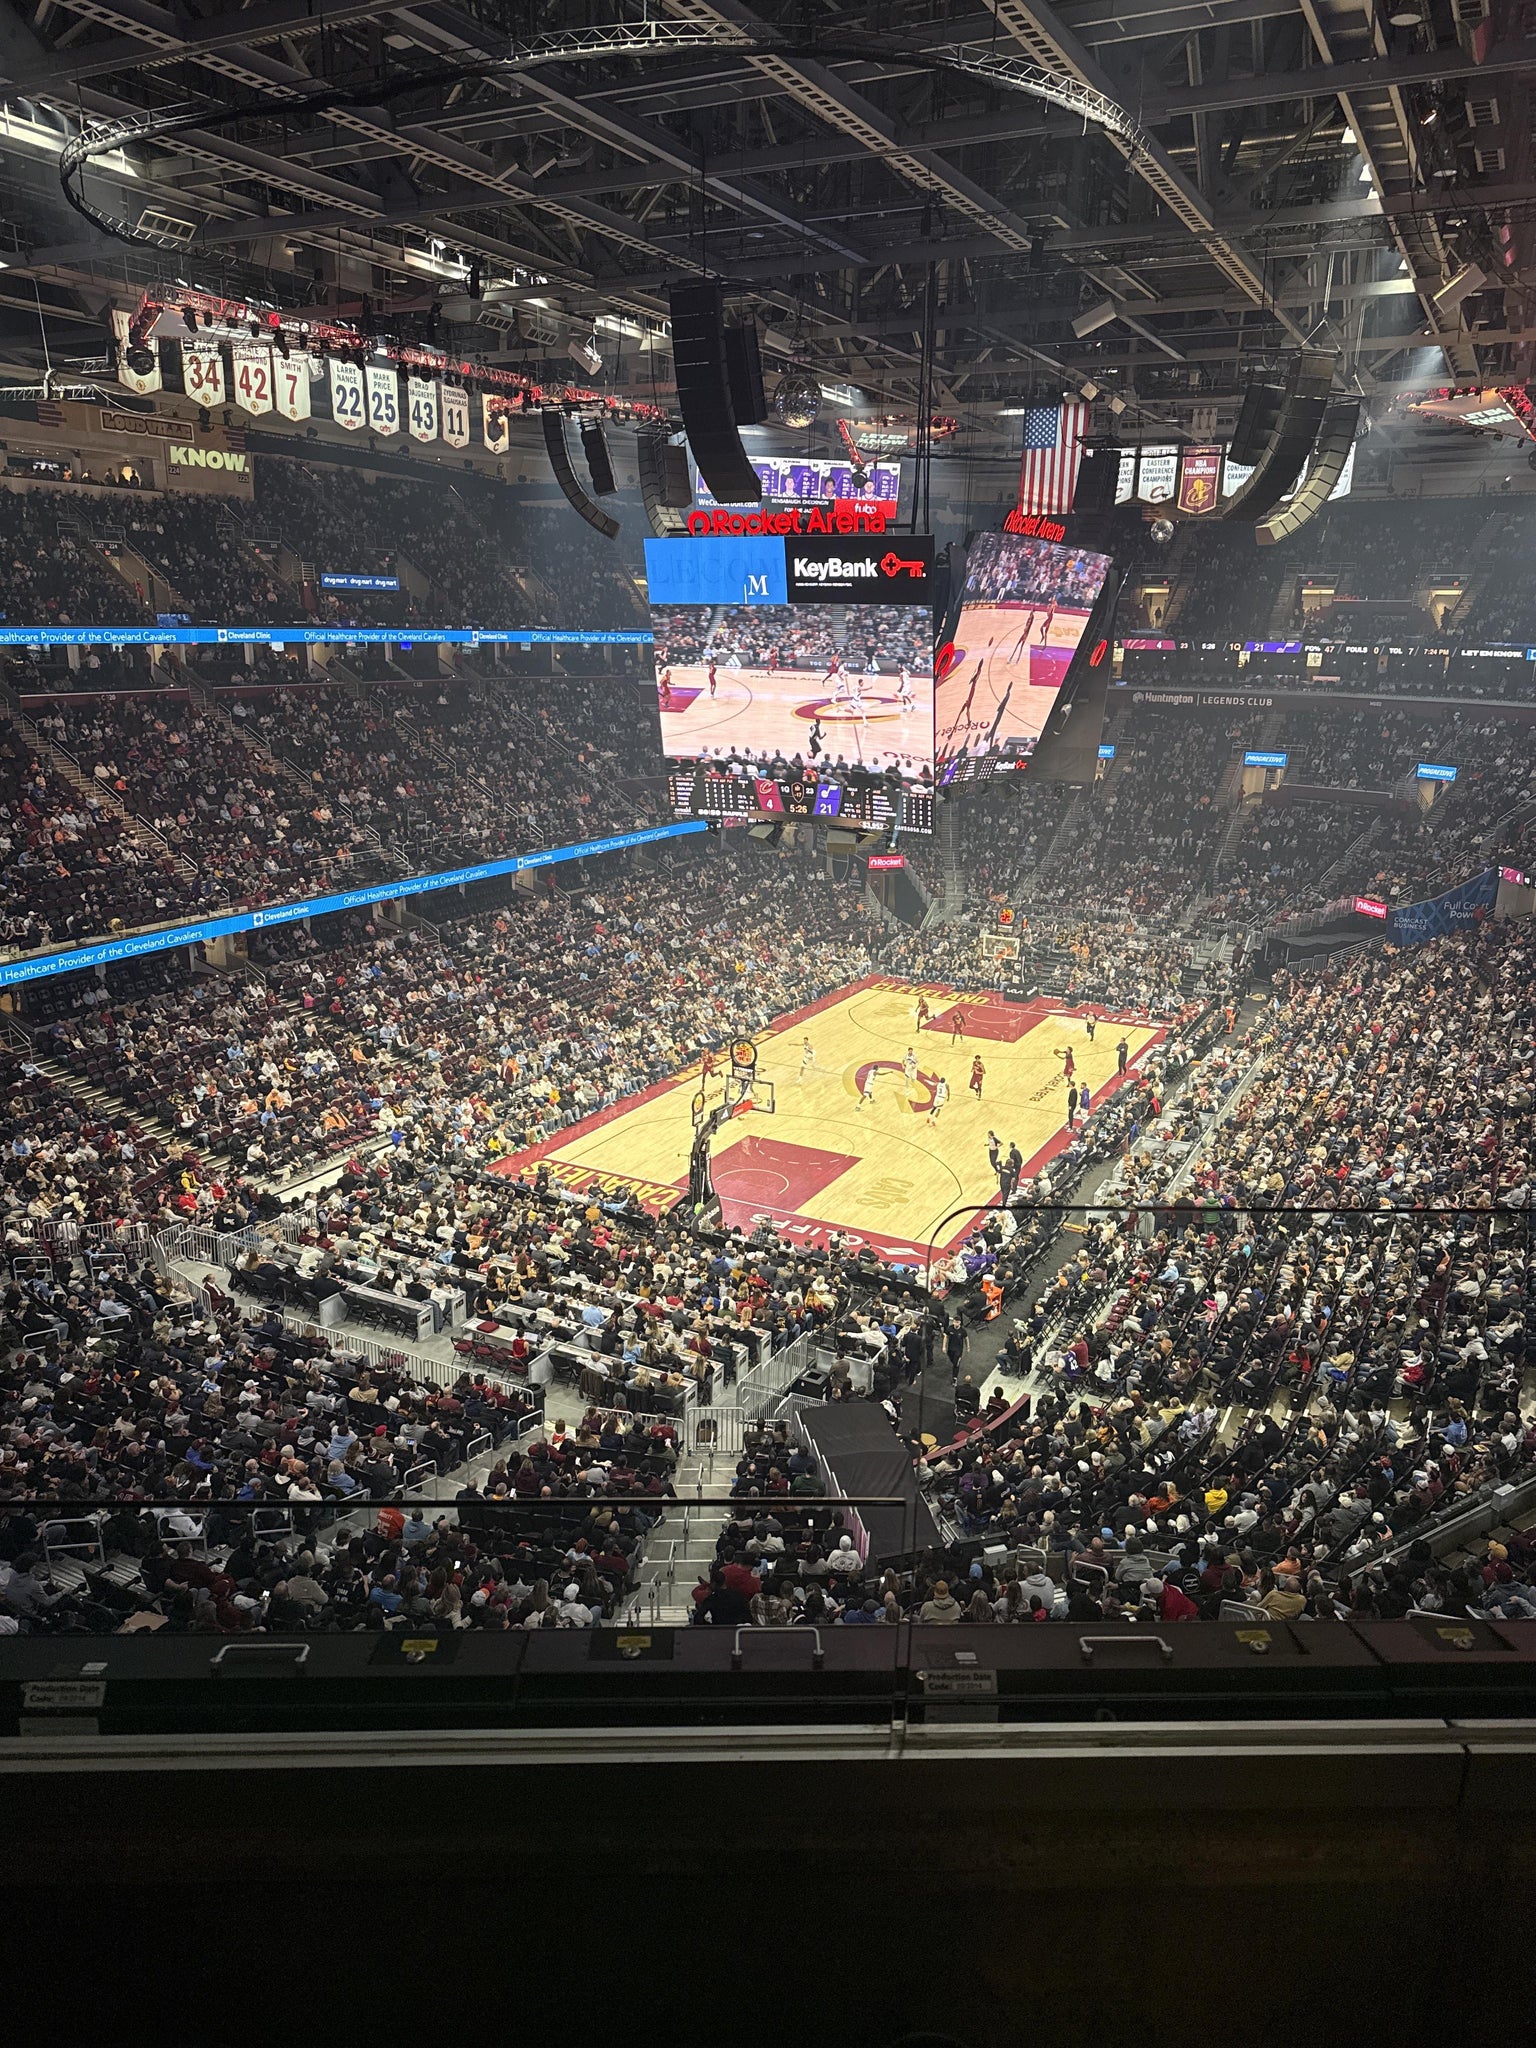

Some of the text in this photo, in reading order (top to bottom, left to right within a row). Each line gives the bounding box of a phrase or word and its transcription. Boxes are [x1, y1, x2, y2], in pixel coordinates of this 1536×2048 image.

[280, 361, 302, 373] SMITH
[336, 365, 357, 376] LARRY
[189, 355, 221, 392] 34
[373, 372, 390, 382] MARK
[239, 365, 268, 400] 42
[336, 374, 358, 385] NANCE
[373, 380, 392, 390] PRICE
[285, 373, 298, 405] 7
[414, 381, 429, 390] BRAD
[335, 384, 362, 418] 22
[371, 390, 396, 423] 25
[411, 400, 434, 431] 43
[447, 407, 465, 437] 11
[170, 445, 250, 473] KNOW.
[1142, 467, 1174, 476] CONFERENCE
[1184, 466, 1216, 475] CHAMPIONS
[1142, 475, 1173, 483] CHAMPIONS
[713, 507, 886, 535] Rocket Arena
[1006, 510, 1066, 542] Rocket Arena
[794, 557, 878, 580] KeyBank
[0, 631, 177, 642] ealthcare Provider of the Cleveland Cavaliers
[228, 631, 271, 640] Cleveland Clinic
[304, 631, 446, 641] Official Healthcare Provider of the Cleveland Cavaliers
[532, 632, 551, 642] Official
[552, 633, 579, 642] Healthcare
[580, 633, 600, 643] Provider
[607, 634, 616, 642] the
[616, 634, 642, 643] Cleveland
[1156, 641, 1162, 649] 4
[1254, 643, 1265, 651] 21
[1324, 646, 1335, 654] 47
[1345, 646, 1380, 655] FOULS 0
[1389, 647, 1414, 656] TOL 7
[1145, 691, 1273, 707] Huntington LEGENDS CLUB
[1246, 755, 1284, 764] PROGRESSIVE
[766, 799, 774, 809] 4
[790, 804, 808, 814] 5:26
[820, 803, 832, 814] 21
[343, 869, 488, 906] Official Healthcare Provider of the Cleveland Cavaliers
[1362, 903, 1386, 915] Rocket
[1443, 901, 1490, 910] Full Cort
[264, 905, 310, 922] Cleveland Clinic
[1450, 910, 1475, 919] Pow
[1394, 916, 1428, 925] COMCAST
[1393, 923, 1427, 931] BUSINESS
[5, 963, 57, 981] Healthcare
[58, 953, 95, 969] Provider
[97, 948, 107, 960] of
[109, 946, 123, 957] the
[125, 938, 165, 953] Cleveland
[167, 930, 203, 945] Cavaliers
[870, 983, 990, 1005] CLEVELAND
[520, 1160, 681, 1206] CAVALIERS
[856, 1177, 914, 1210] CAVS
[928, 1673, 992, 1682] Production Date
[32, 1684, 100, 1693] Production Date
[928, 1683, 951, 1691] Code:
